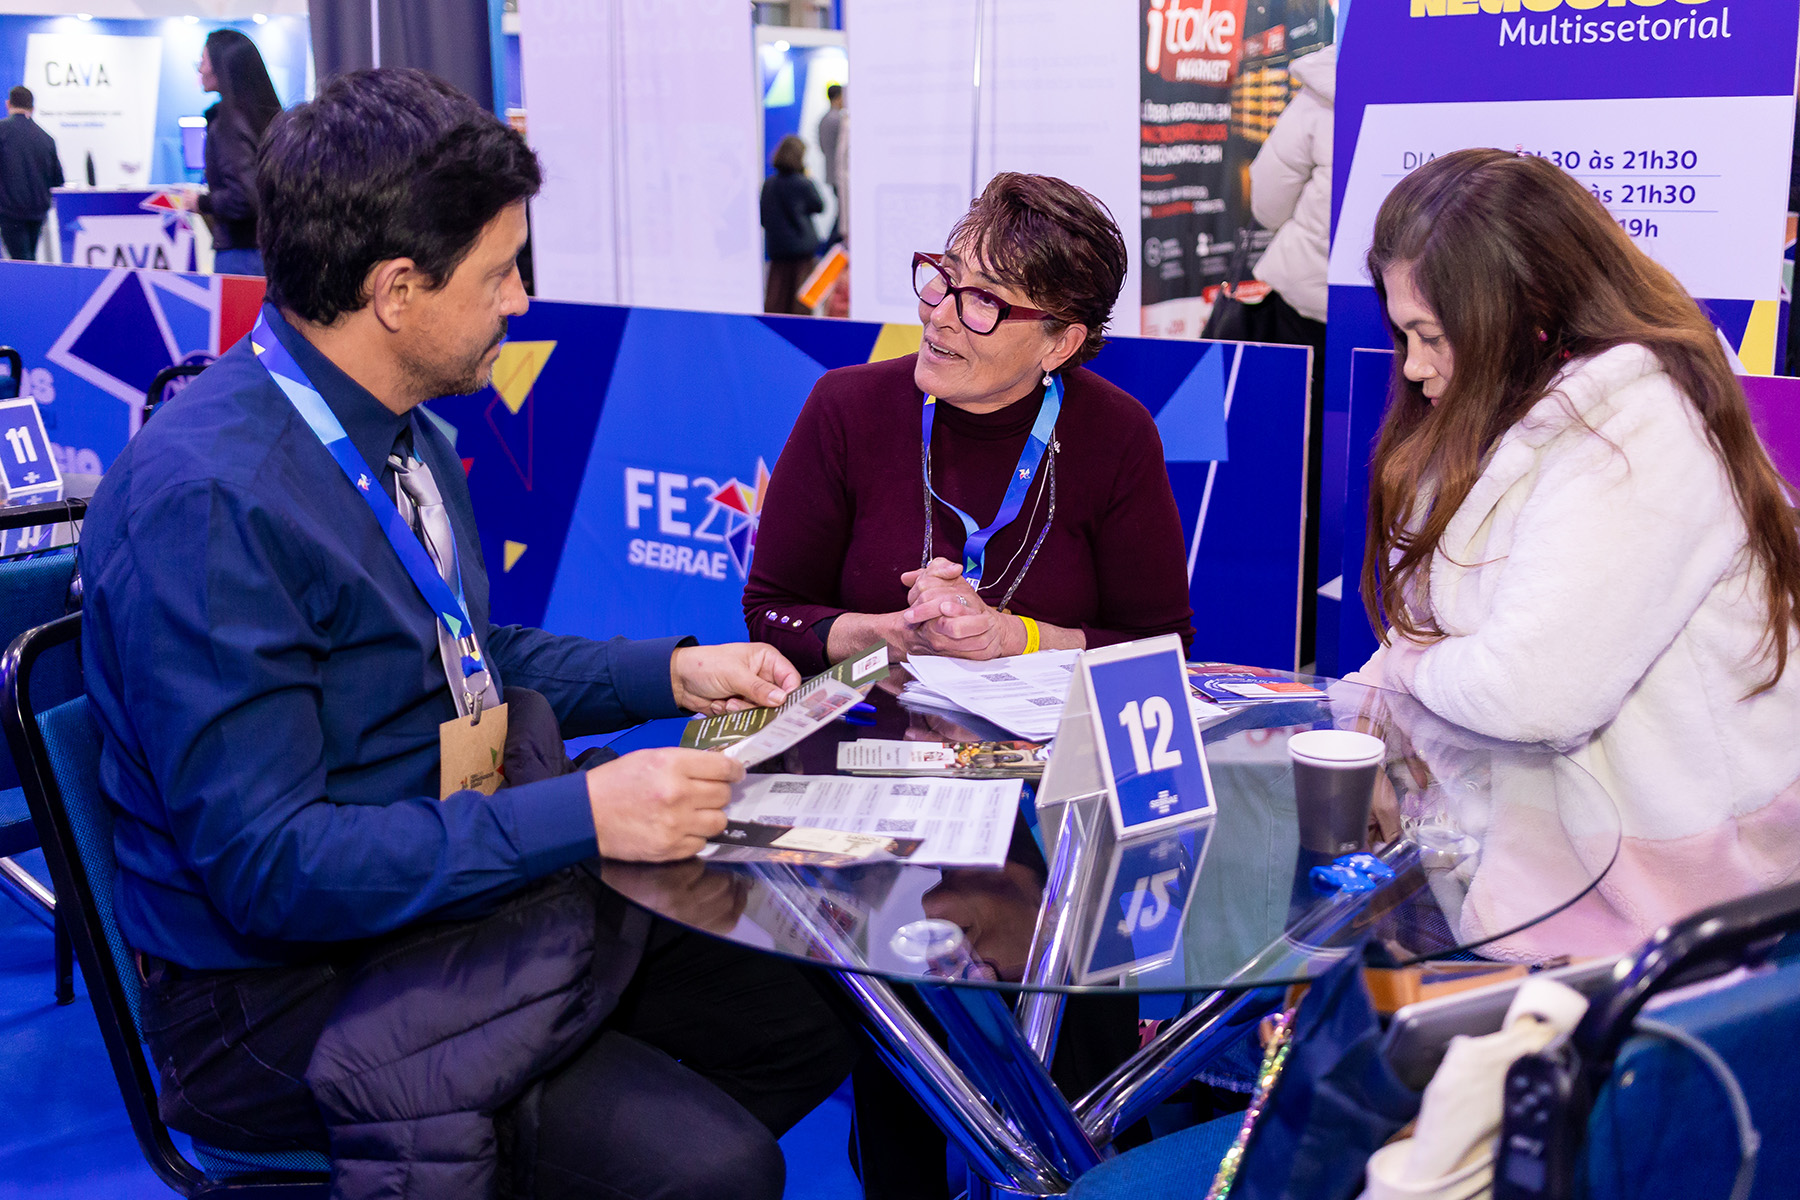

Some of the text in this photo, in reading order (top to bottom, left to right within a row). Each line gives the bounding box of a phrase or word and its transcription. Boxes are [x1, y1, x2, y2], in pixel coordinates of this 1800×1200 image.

[1498, 7, 1732, 47] Multissetorial
[45, 61, 111, 87] CAVA
[1175, 58, 1232, 82] MARKET
[1588, 149, 1614, 170] às
[1622, 150, 1698, 170] 21h30
[1621, 184, 1697, 204] 21h30
[86, 244, 170, 269] CAVA
[5, 426, 38, 464] 11
[627, 538, 729, 581] SEBRAE
[1118, 696, 1183, 774] 12
